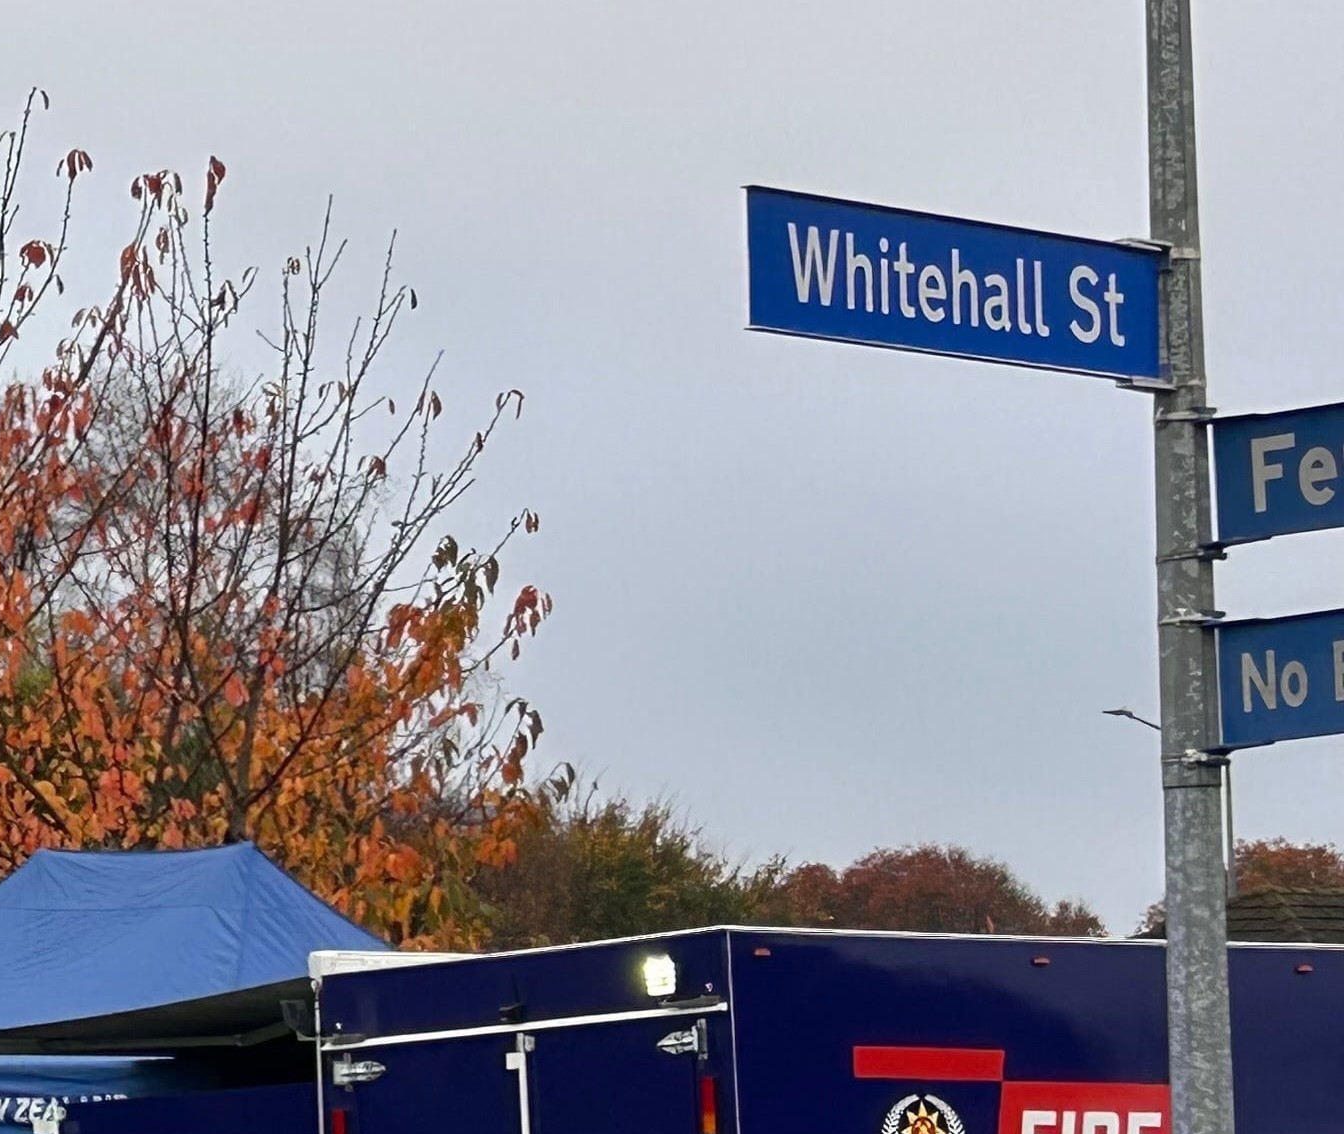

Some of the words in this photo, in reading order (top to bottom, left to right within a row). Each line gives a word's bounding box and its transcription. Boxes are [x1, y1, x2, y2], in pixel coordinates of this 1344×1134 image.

[786, 221, 1050, 337] Whitehall
[1068, 264, 1125, 347] St
[1250, 432, 1344, 513] Fe
[1241, 649, 1308, 713] No
